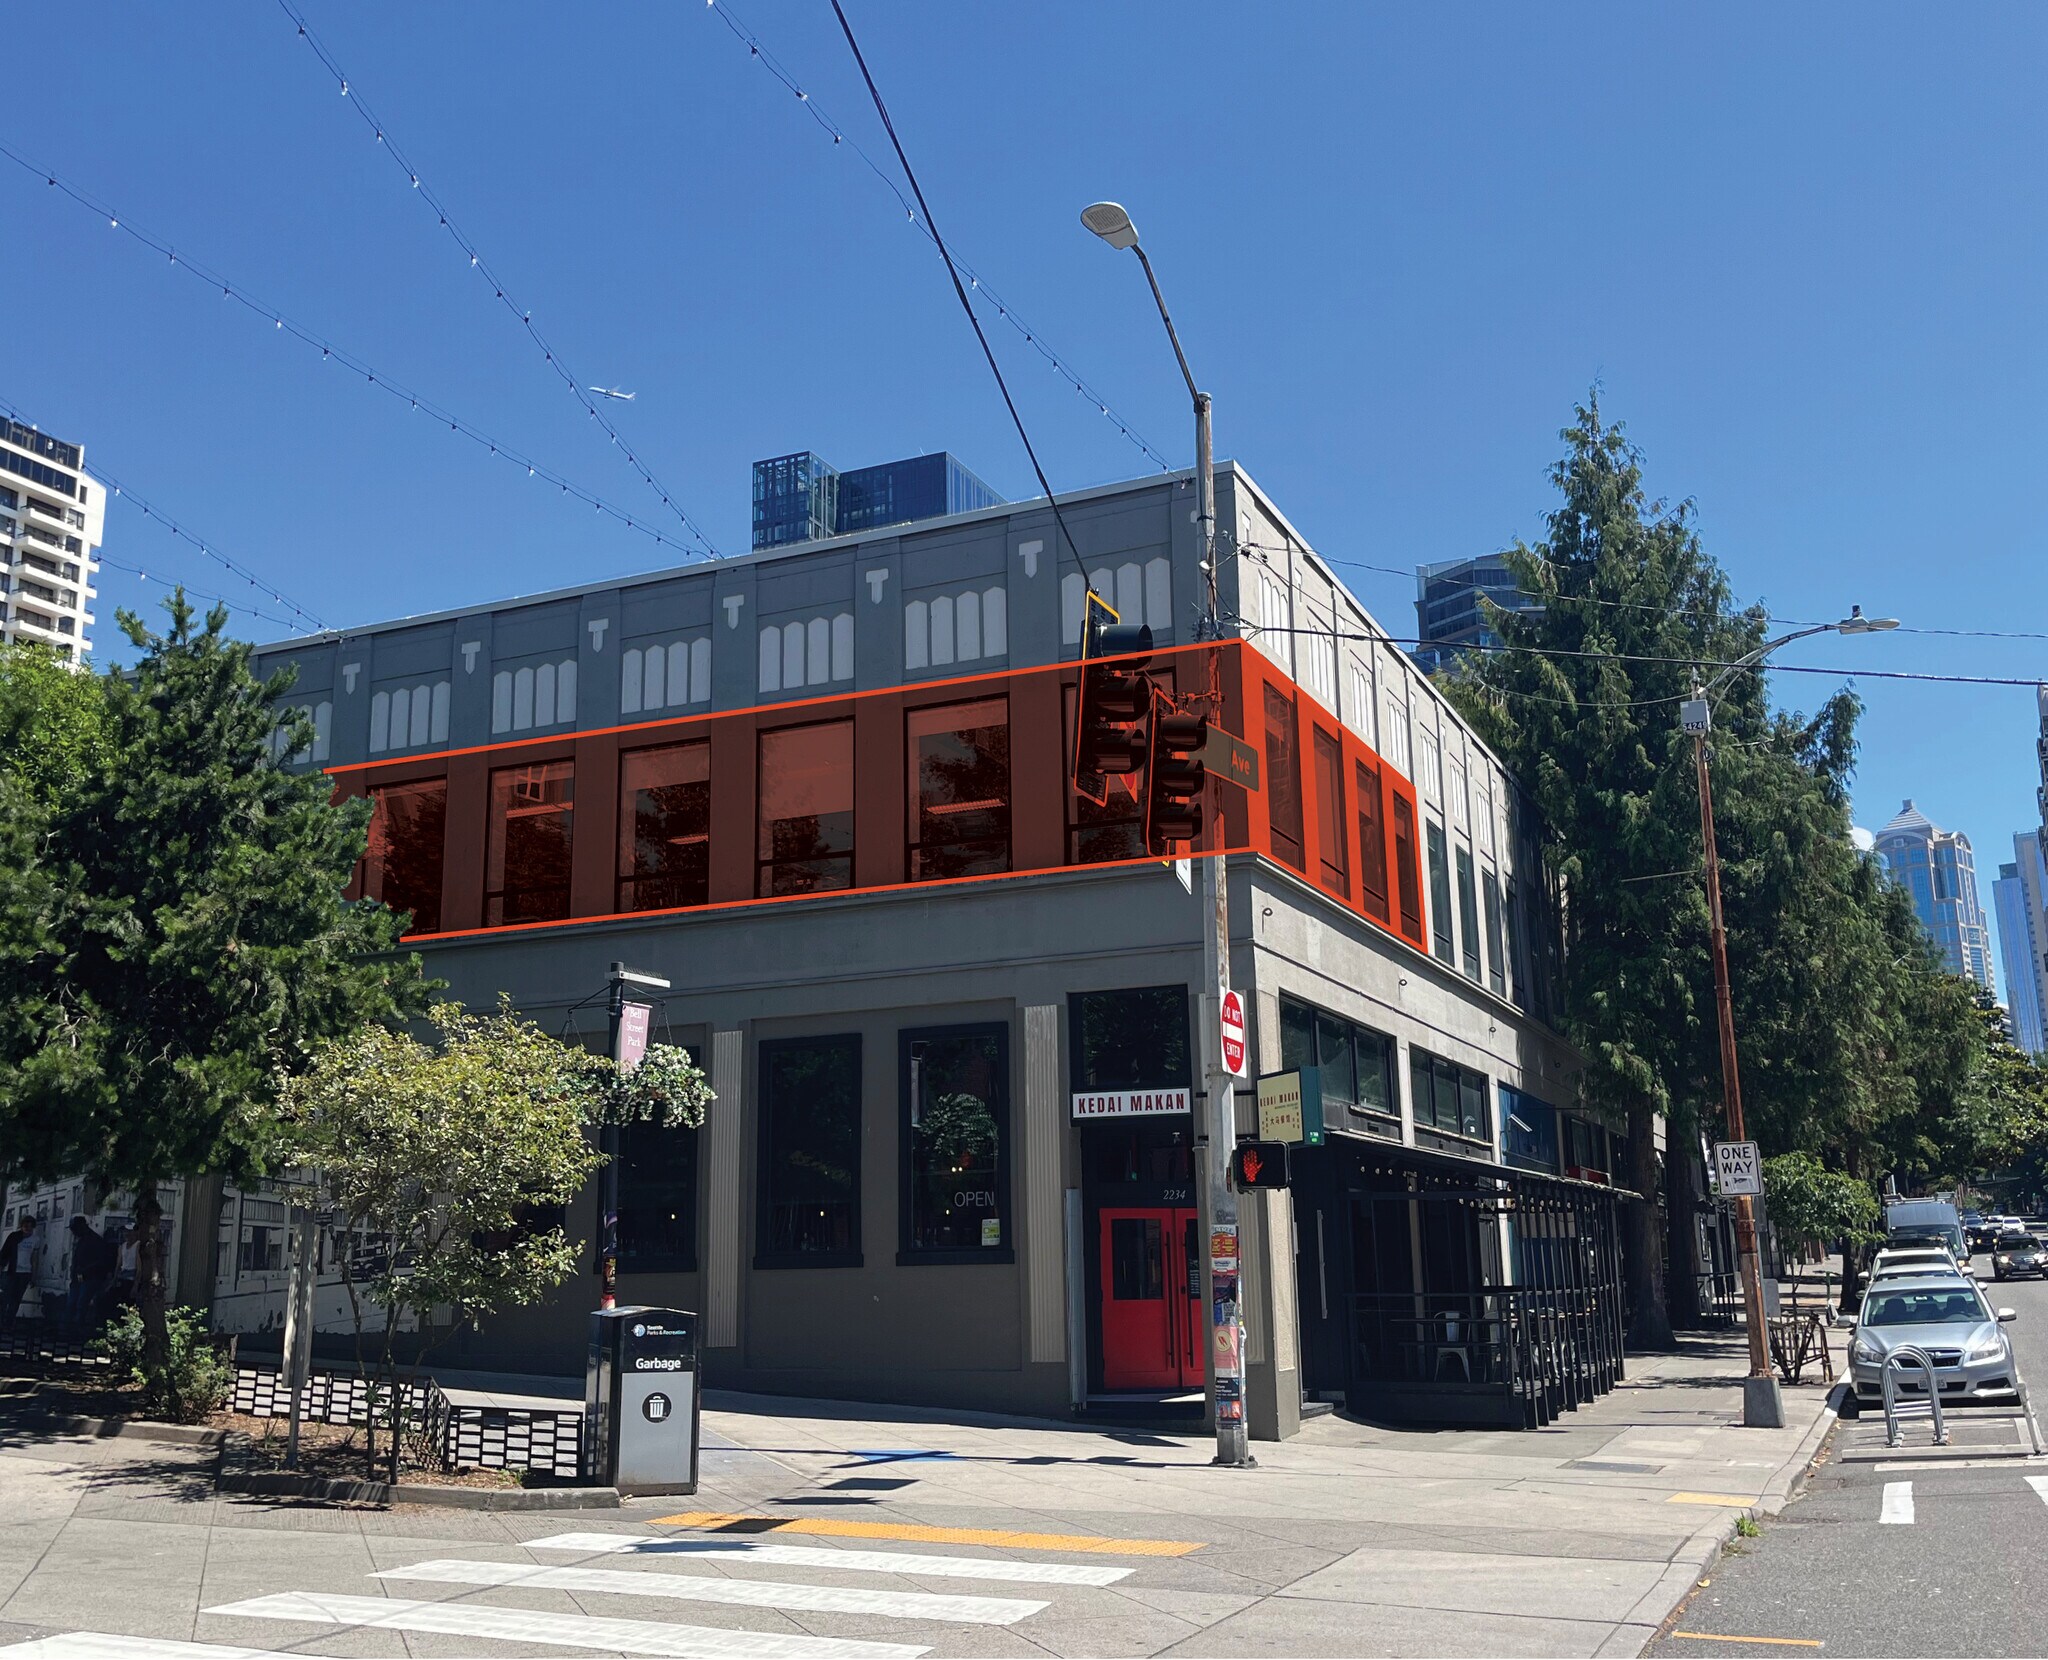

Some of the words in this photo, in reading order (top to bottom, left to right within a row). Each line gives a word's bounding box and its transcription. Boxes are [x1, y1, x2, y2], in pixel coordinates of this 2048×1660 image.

[1232, 749, 1250, 776] Ave
[630, 1009, 642, 1019] Bell
[1224, 1005, 1231, 1019] DO
[1231, 1008, 1241, 1023] NOT
[626, 1022, 644, 1033] Street
[627, 1036, 641, 1047] Park
[1226, 1041, 1241, 1059] ENTER
[1078, 1096, 1122, 1114] KEDAI
[1130, 1093, 1185, 1112] MAKAN
[1721, 1147, 1751, 1159] ONE
[1721, 1161, 1753, 1174] WAY
[954, 1191, 995, 1207] OPEN
[1163, 1189, 1186, 1200] 2234
[635, 1357, 682, 1371] Garbage
